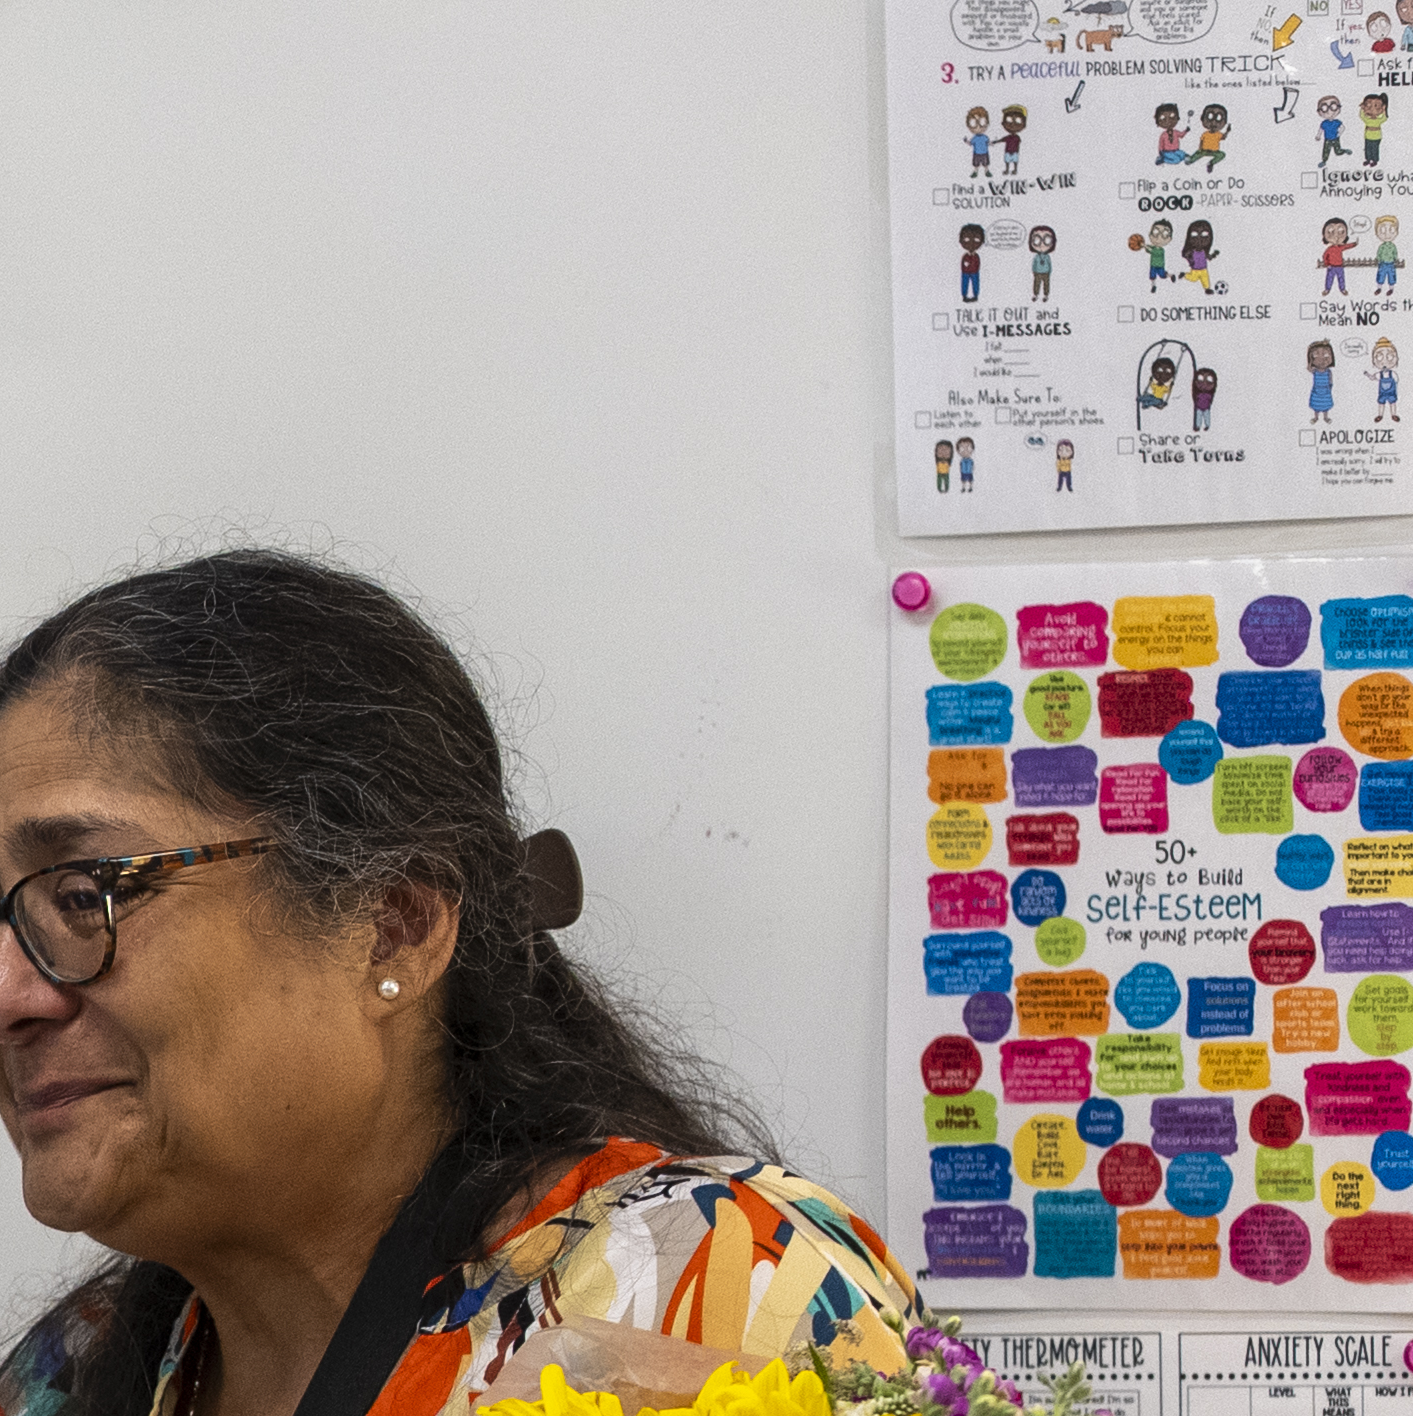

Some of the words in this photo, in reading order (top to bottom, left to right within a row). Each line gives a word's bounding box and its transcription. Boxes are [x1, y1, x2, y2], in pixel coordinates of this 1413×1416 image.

[1378, 58, 1401, 70] Ask
[941, 62, 959, 84] 3.
[968, 66, 994, 81] TRY
[998, 65, 1006, 81] A
[1086, 60, 1145, 76] PROBLEM
[1150, 58, 1202, 74] SOLVING
[1185, 78, 1200, 88] like
[1205, 78, 1218, 88] the
[1246, 76, 1272, 87] listed
[1378, 72, 1413, 87] HEL
[1322, 168, 1384, 187] Ignore
[952, 183, 973, 195] Find
[1138, 179, 1156, 194] Flip
[1162, 182, 1168, 191] a
[1173, 178, 1202, 191] Coin
[1207, 180, 1222, 190] or
[1228, 177, 1244, 189] Do
[1320, 185, 1382, 201] Annoying
[952, 196, 1011, 209] SOLUTION
[1140, 308, 1157, 322] DO
[1161, 306, 1236, 321] SOMETHING
[1240, 305, 1271, 319] ELSE
[1319, 300, 1345, 316] Say
[1350, 300, 1397, 312] Words
[956, 308, 984, 323] TALK
[1003, 307, 1029, 321] OUT
[1036, 307, 1059, 320] and
[1319, 314, 1352, 326] Mean
[1356, 312, 1379, 326] NO
[953, 325, 977, 337] Use
[948, 390, 973, 405] Also
[978, 389, 1009, 405] Make
[1014, 388, 1041, 404] Sure
[934, 410, 961, 419] Listen
[1012, 409, 1028, 420] Put
[1032, 407, 1066, 419] yourself
[1083, 407, 1097, 417] the
[1140, 434, 1180, 447] Share
[1185, 435, 1200, 446] or
[1320, 429, 1394, 444] APOLOGIZE
[1155, 839, 1197, 864] 50+
[1106, 869, 1156, 895] Ways
[1166, 871, 1187, 886] to
[1199, 868, 1242, 885] Build
[1194, 927, 1248, 945] people
[1204, 982, 1233, 991] Focus
[1237, 983, 1249, 991] on
[1201, 1010, 1236, 1019] instead
[1239, 1010, 1249, 1019] of
[945, 1105, 975, 1118] Help
[1090, 1111, 1115, 1120] Drink
[935, 1117, 981, 1130] others.
[1384, 1149, 1409, 1158] Trust
[1332, 1172, 1346, 1181] Do
[1348, 1172, 1363, 1181] the
[1337, 1182, 1359, 1190] next
[1336, 1191, 1360, 1201] right
[1335, 1200, 1362, 1210] thing.
[1001, 1336, 1145, 1369] THERMOMETER
[1245, 1335, 1323, 1368] ANXIETY
[1334, 1335, 1392, 1367] SCALE
[1269, 1387, 1296, 1398] LEVEL
[1325, 1387, 1351, 1397] WHAT
[1375, 1387, 1397, 1397] HOW
[1328, 1397, 1349, 1408] THIS
